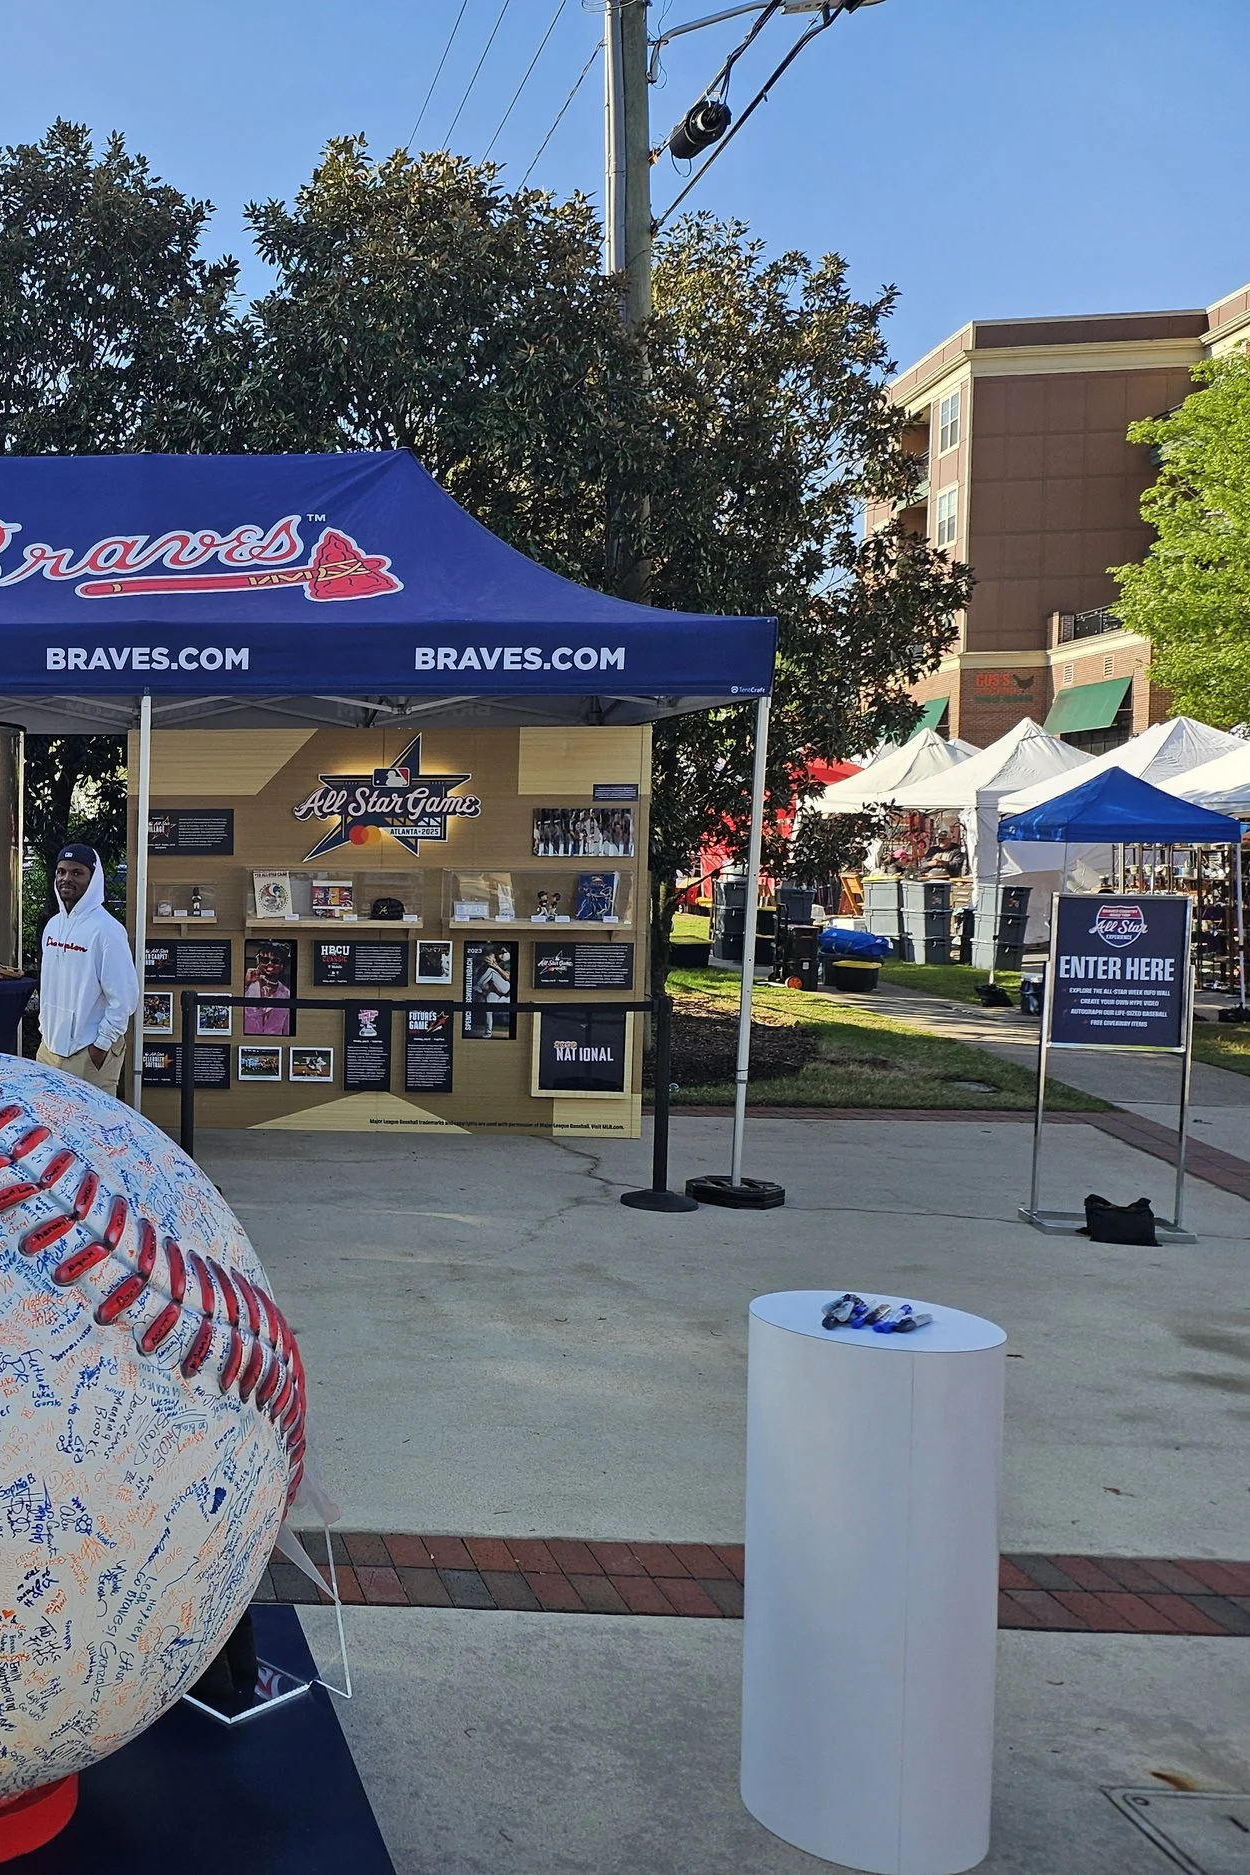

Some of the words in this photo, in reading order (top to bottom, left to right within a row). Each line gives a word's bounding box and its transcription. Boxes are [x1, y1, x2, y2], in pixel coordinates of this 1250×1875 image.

[46, 647, 249, 670] BRAVES.COM
[415, 647, 626, 670] BRAVES.COM
[294, 786, 348, 818] All
[349, 787, 403, 816] Star
[405, 787, 480, 819] Game
[1089, 920, 1118, 933] All
[1118, 920, 1148, 934] Star
[321, 946, 350, 955] HBCU
[1059, 956, 1121, 980] ENTER
[1126, 958, 1175, 982] HERE
[409, 1012, 437, 1020] FUTURES
[409, 1021, 428, 1030] GAME
[126, 1600, 156, 1642] Hayden
